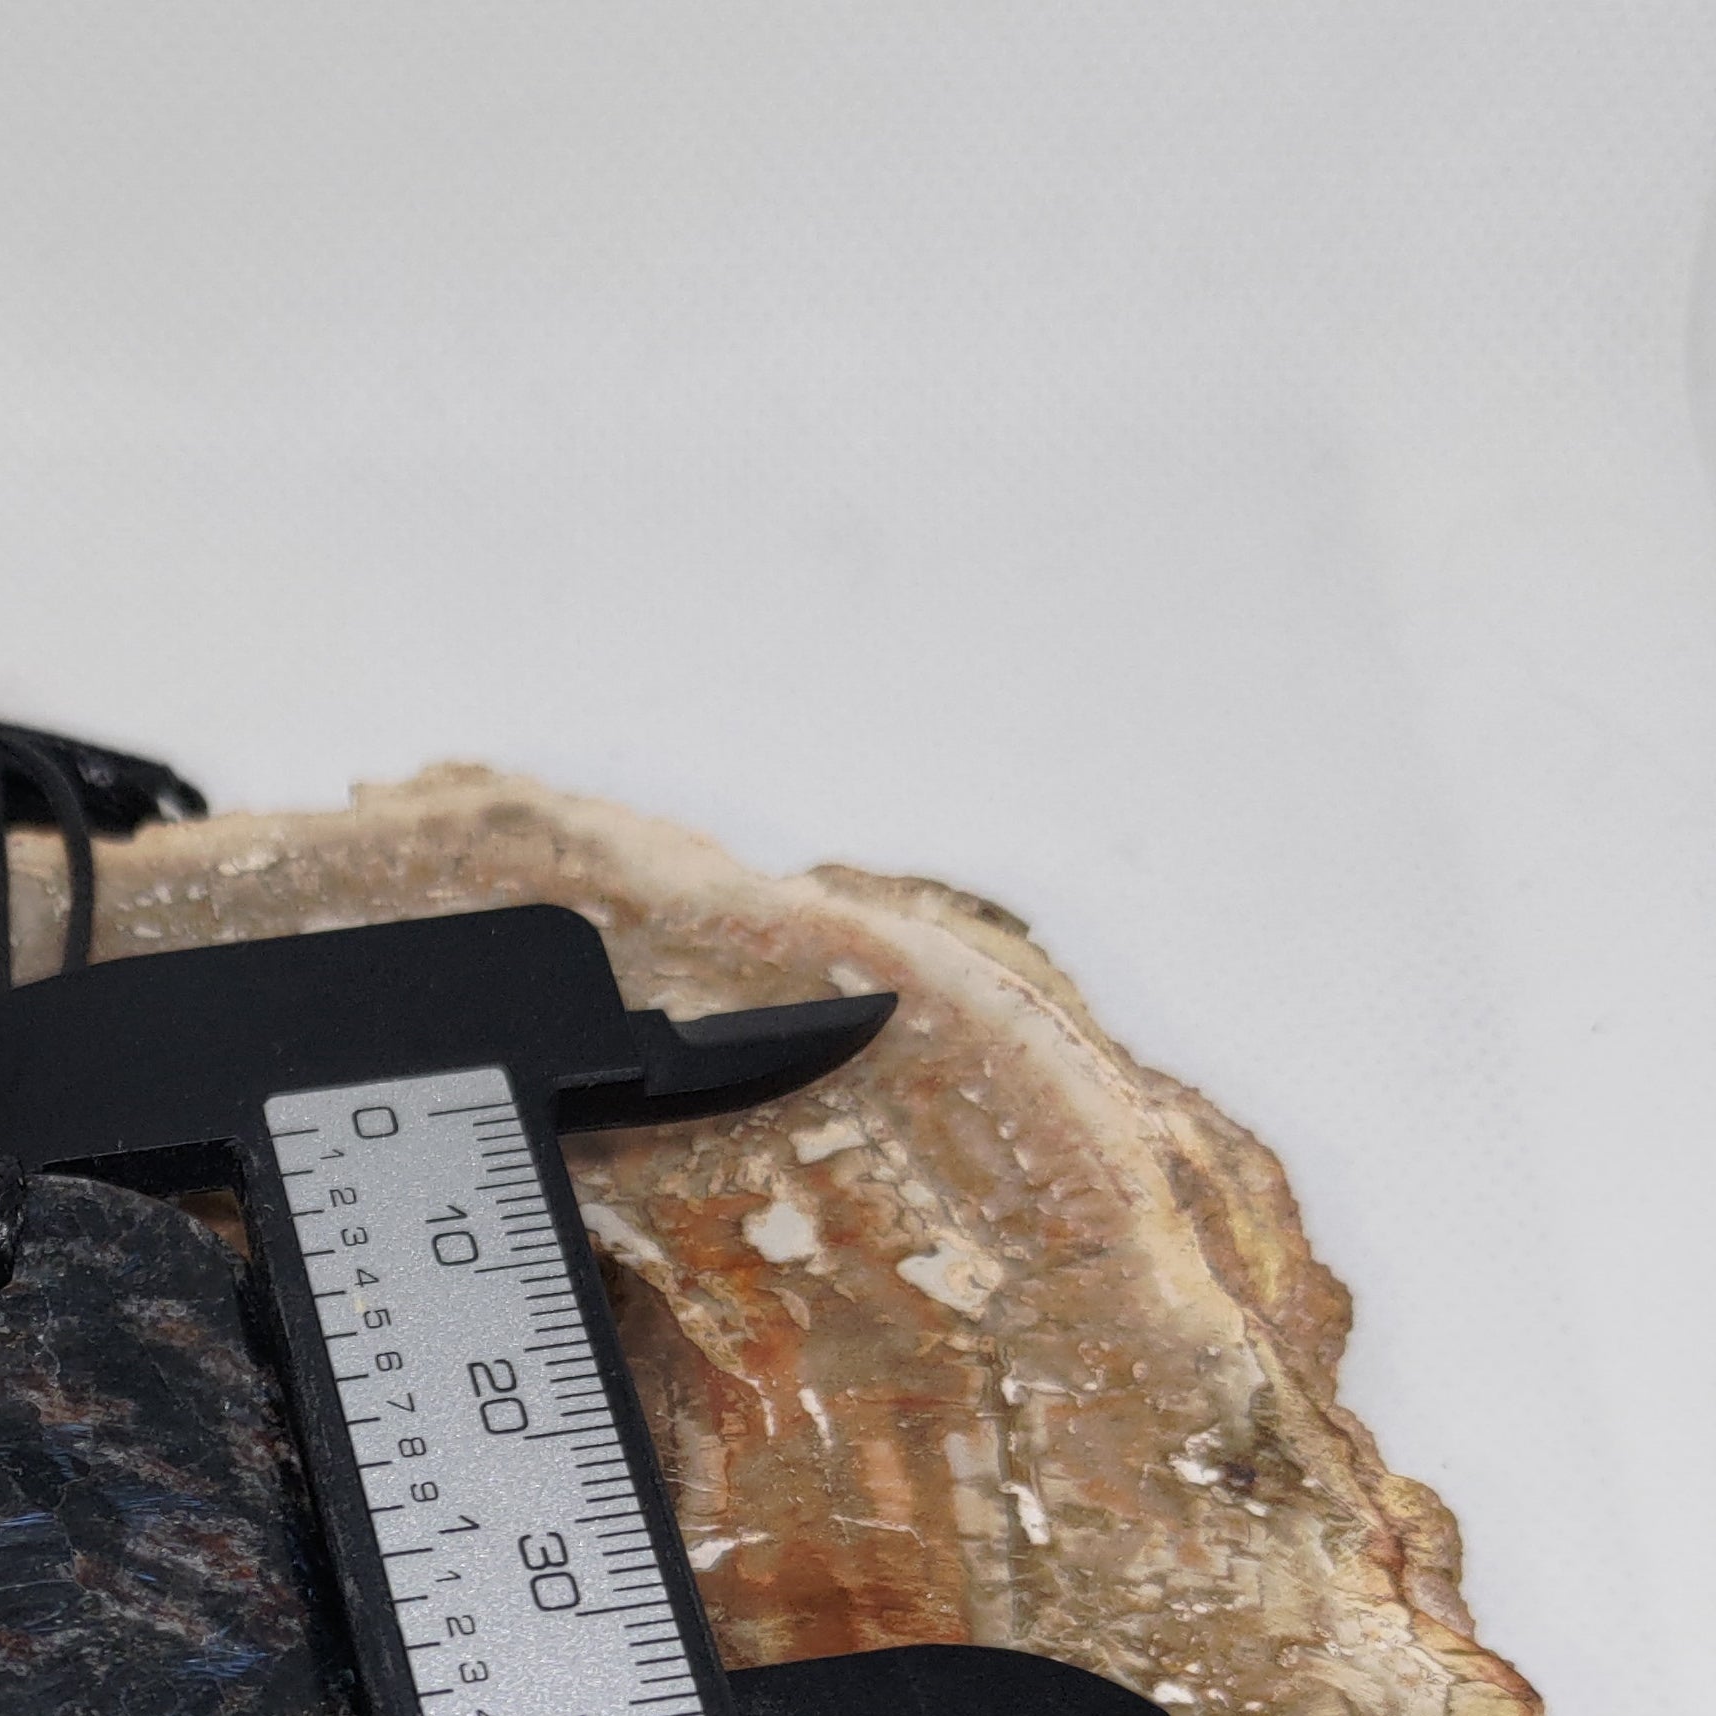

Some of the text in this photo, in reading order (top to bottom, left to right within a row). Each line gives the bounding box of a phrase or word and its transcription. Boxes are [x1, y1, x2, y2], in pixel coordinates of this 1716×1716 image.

[320, 1148, 345, 1161] 1
[329, 1187, 357, 1208] 2
[340, 1226, 369, 1248] 3
[355, 1268, 380, 1288] 4
[363, 1308, 392, 1330] 5
[352, 1106, 399, 1139] 0
[425, 1204, 479, 1267] 10
[467, 1358, 529, 1435] 20
[517, 1532, 581, 1612] 30
[375, 1351, 403, 1372] 6
[387, 1393, 416, 1414] 7
[398, 1437, 427, 1459] 8
[410, 1481, 440, 1503] 9
[439, 1515, 480, 1535] 1
[436, 1570, 462, 1583] 1
[446, 1614, 476, 1638] 2
[459, 1661, 489, 1684] 3
